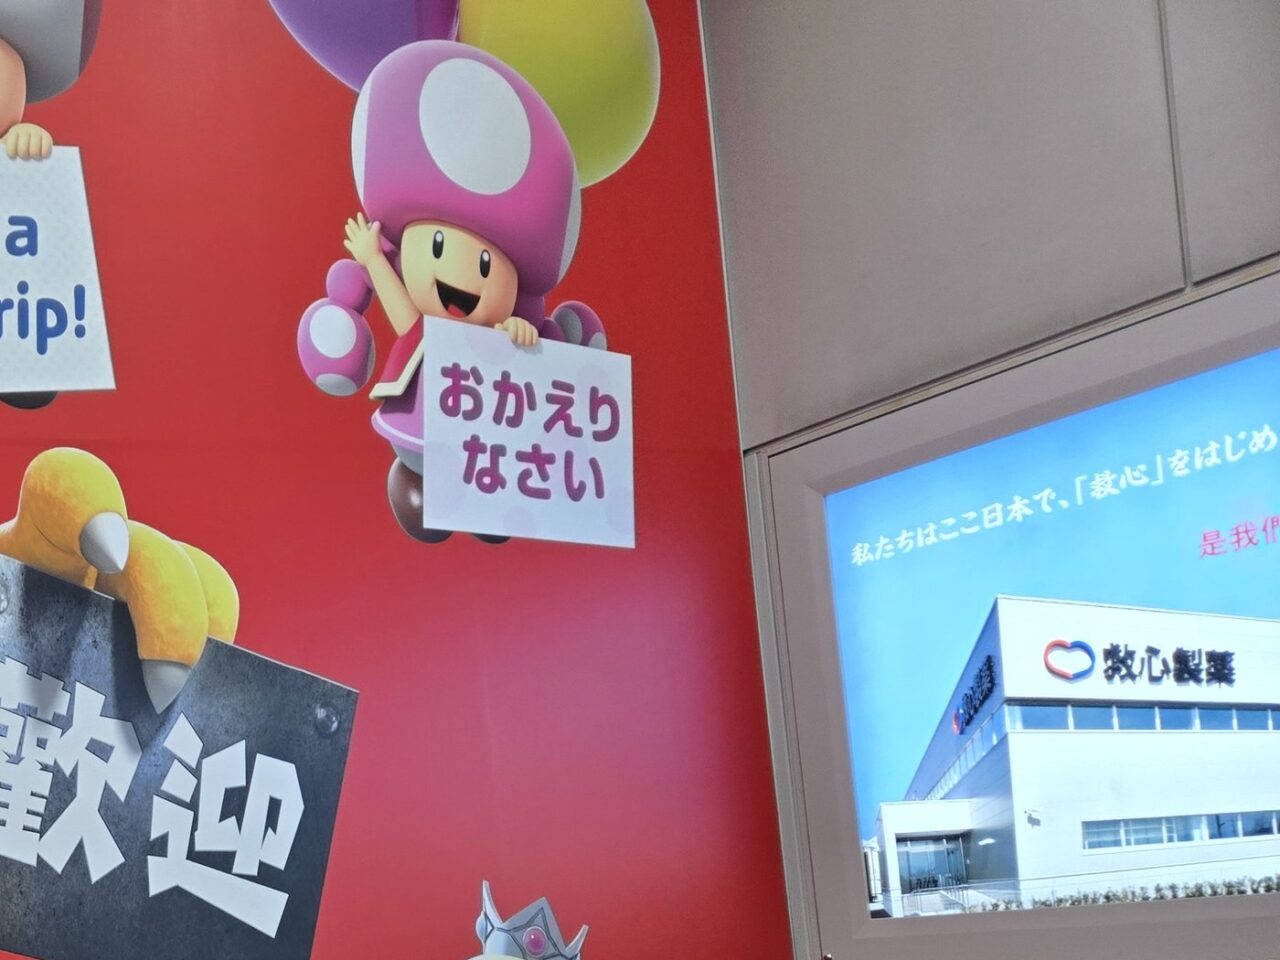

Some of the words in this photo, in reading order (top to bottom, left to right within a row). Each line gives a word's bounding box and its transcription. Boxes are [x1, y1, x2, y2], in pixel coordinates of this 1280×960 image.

[5, 215, 38, 257] a
[439, 362, 620, 442] おかえり
[463, 434, 605, 502] なさい
